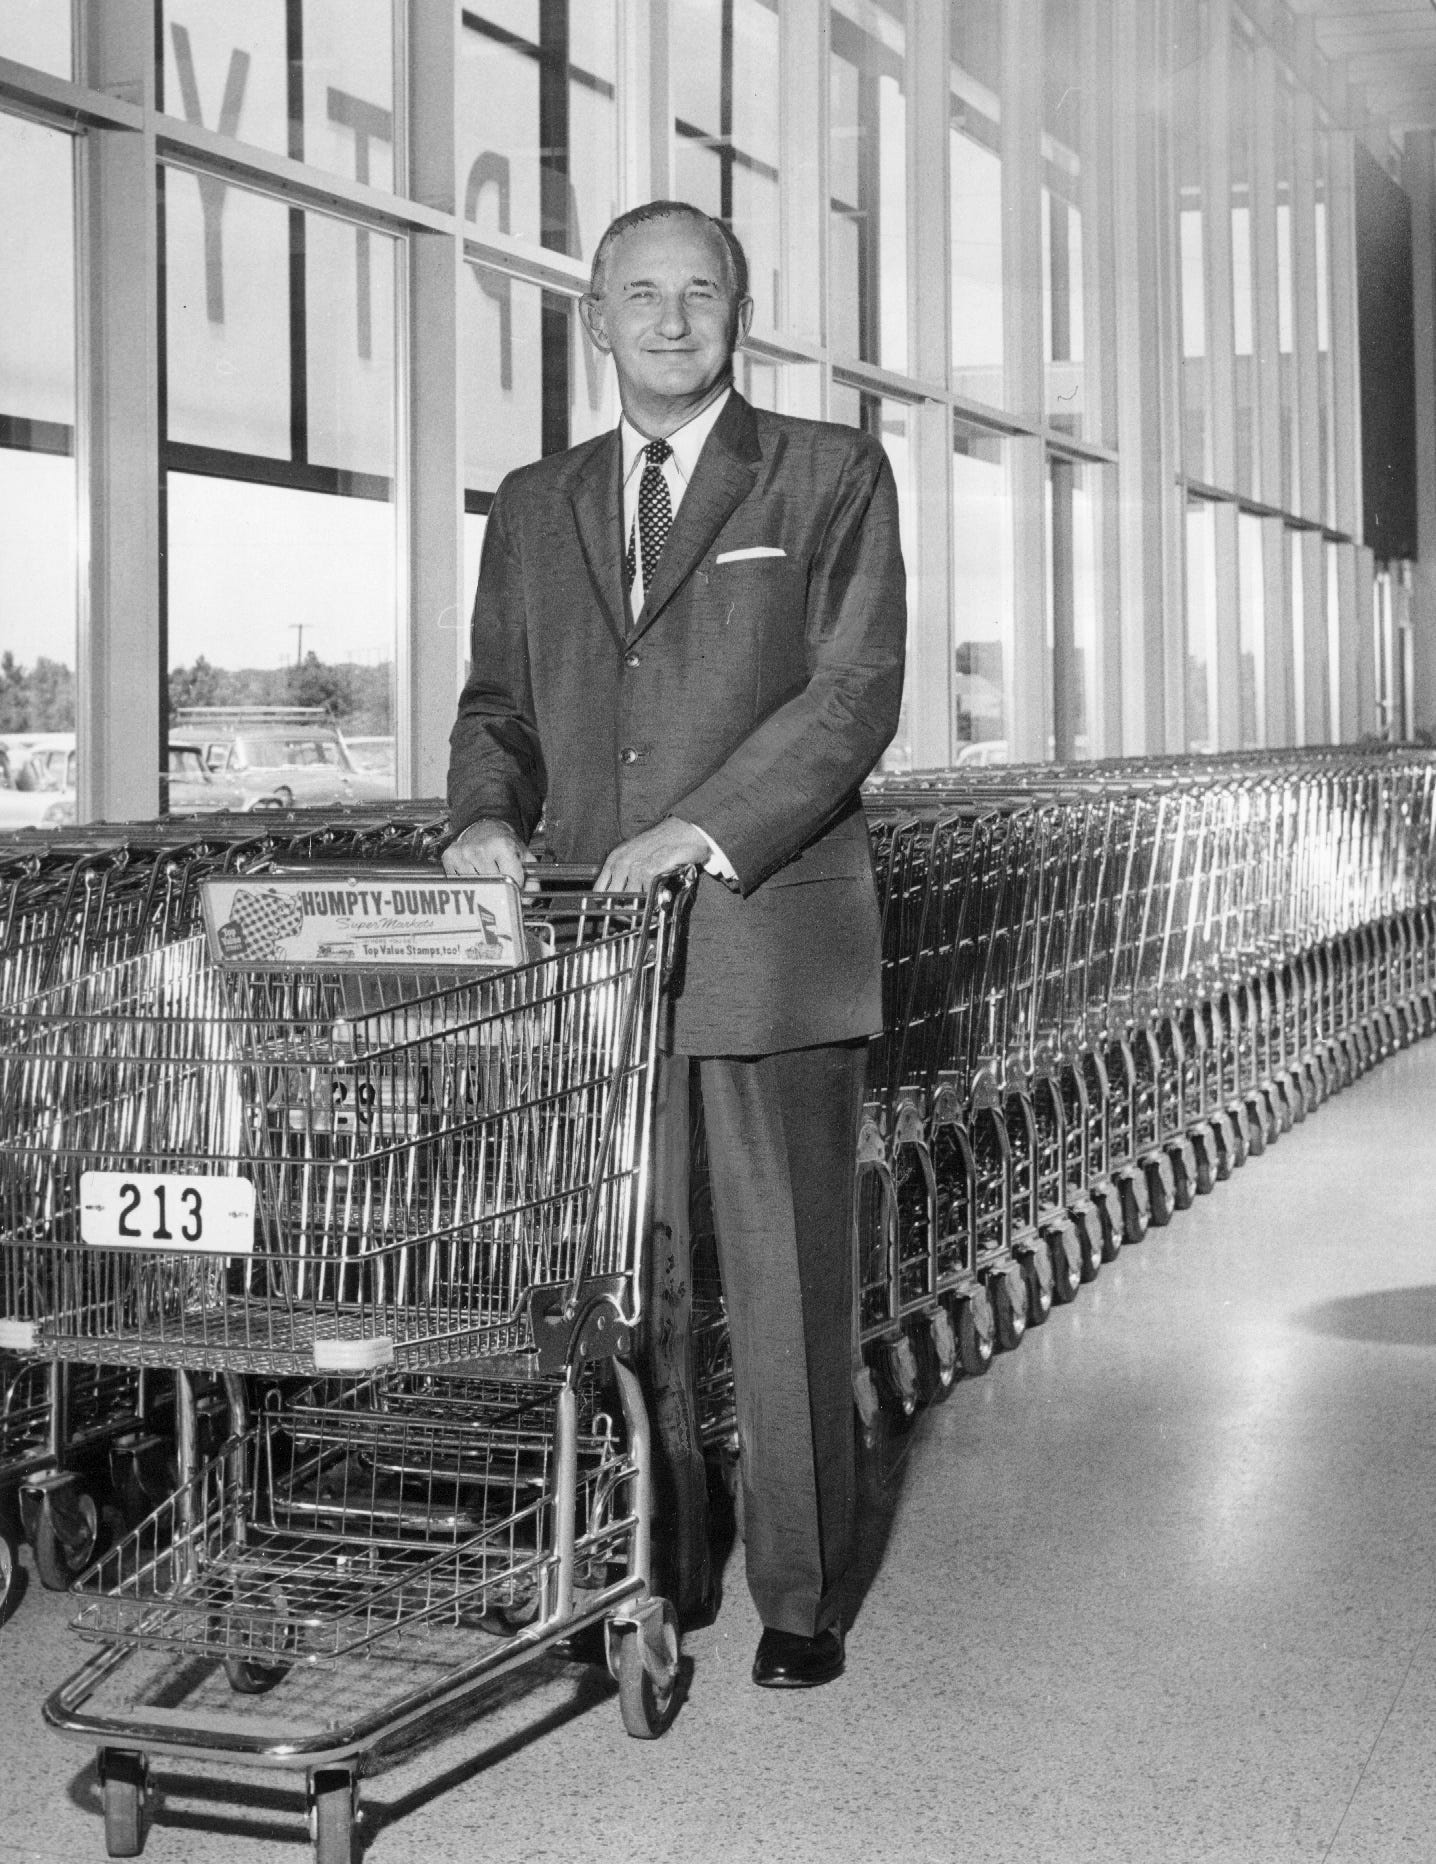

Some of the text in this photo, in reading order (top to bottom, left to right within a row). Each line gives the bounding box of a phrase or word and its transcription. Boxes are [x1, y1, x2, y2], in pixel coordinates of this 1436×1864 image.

[301, 890, 475, 916] HUMPTY-DUMPTY
[335, 917, 434, 932] Super Markets
[362, 944, 379, 958] Top
[380, 944, 405, 955] Value
[118, 1183, 203, 1242] 213
